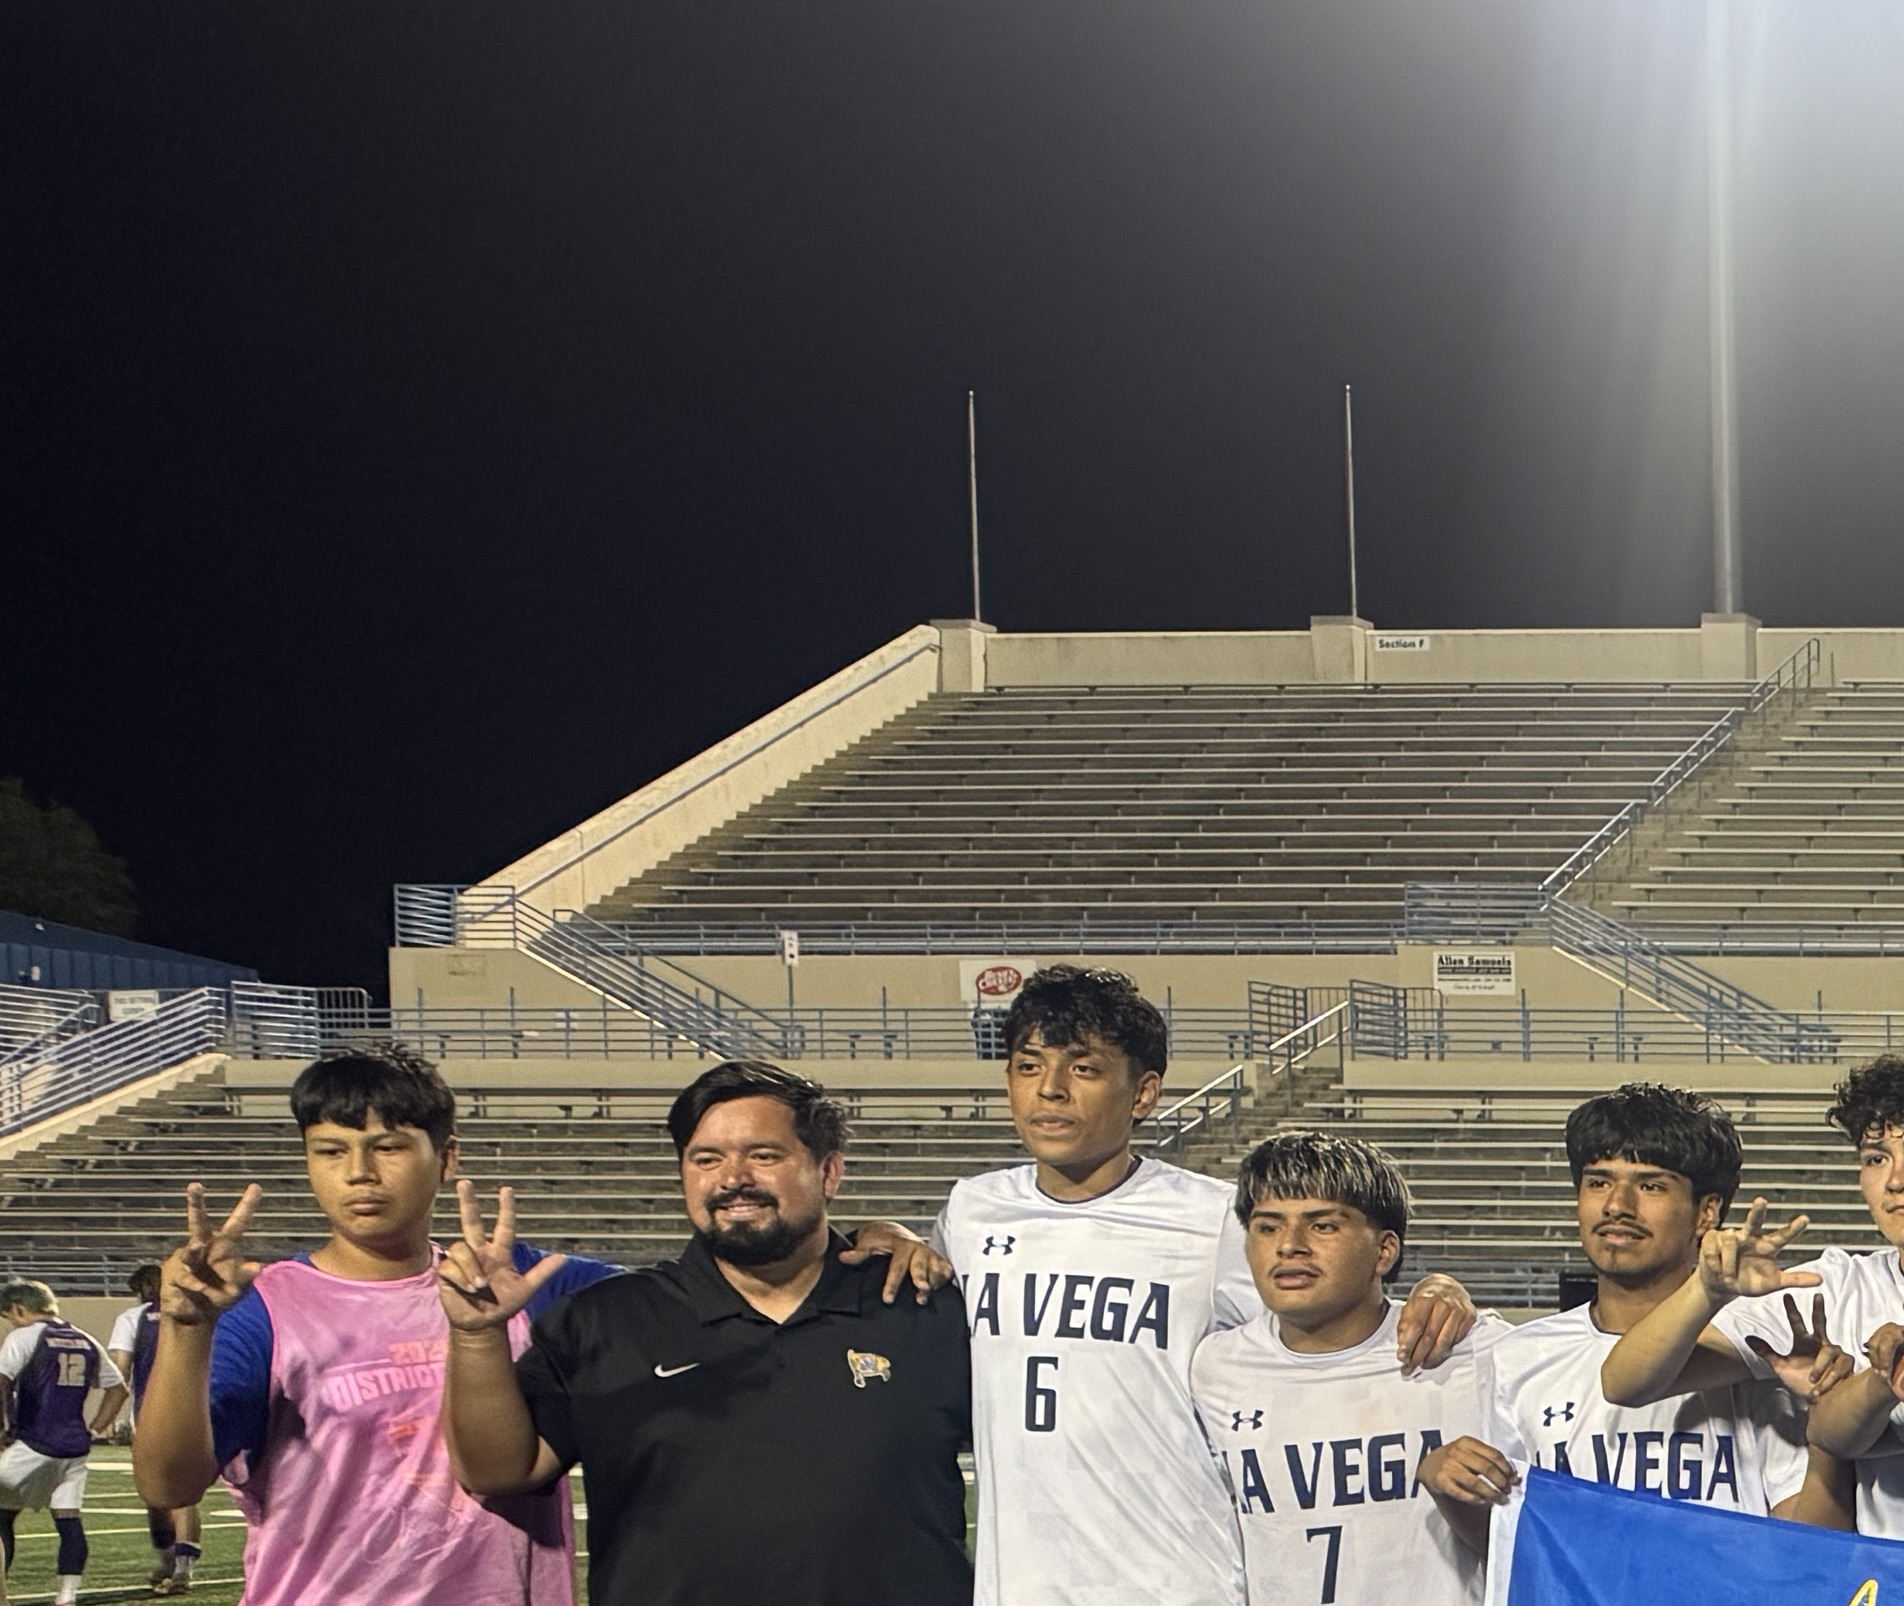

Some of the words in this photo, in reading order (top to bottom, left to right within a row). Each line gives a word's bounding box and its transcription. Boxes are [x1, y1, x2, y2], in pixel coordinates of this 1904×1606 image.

[963, 1272, 1000, 1336] A
[1022, 1273, 1170, 1350] VEGA
[58, 1352, 86, 1386] 12
[1025, 1356, 1059, 1432] 6
[1591, 1431, 1739, 1503] VEGA
[1306, 1525, 1342, 1604] 7
